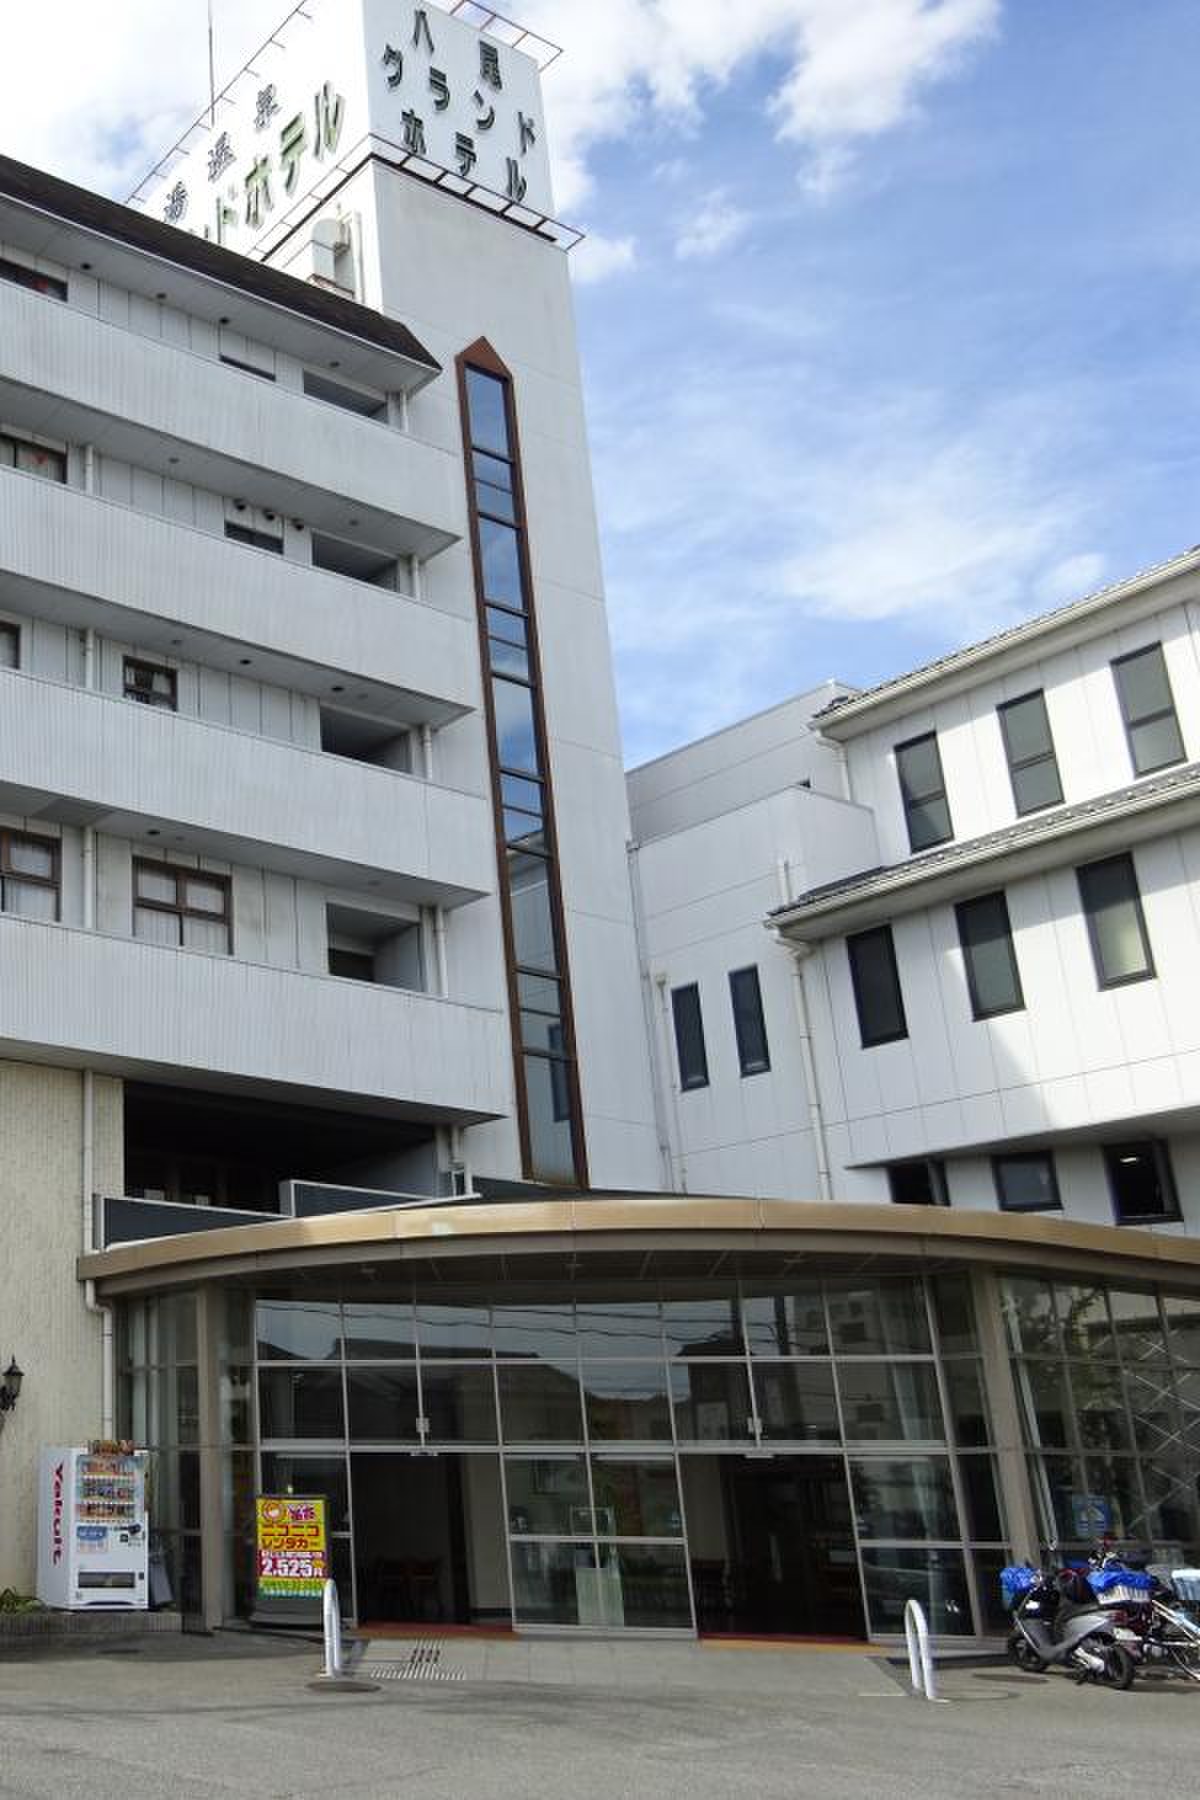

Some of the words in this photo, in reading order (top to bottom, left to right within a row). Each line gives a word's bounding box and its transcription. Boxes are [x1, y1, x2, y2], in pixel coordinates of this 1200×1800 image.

[204, 80, 346, 245] ドホテル
[401, 107, 528, 203] ホテル
[260, 1523, 321, 1537] ニコニコ
